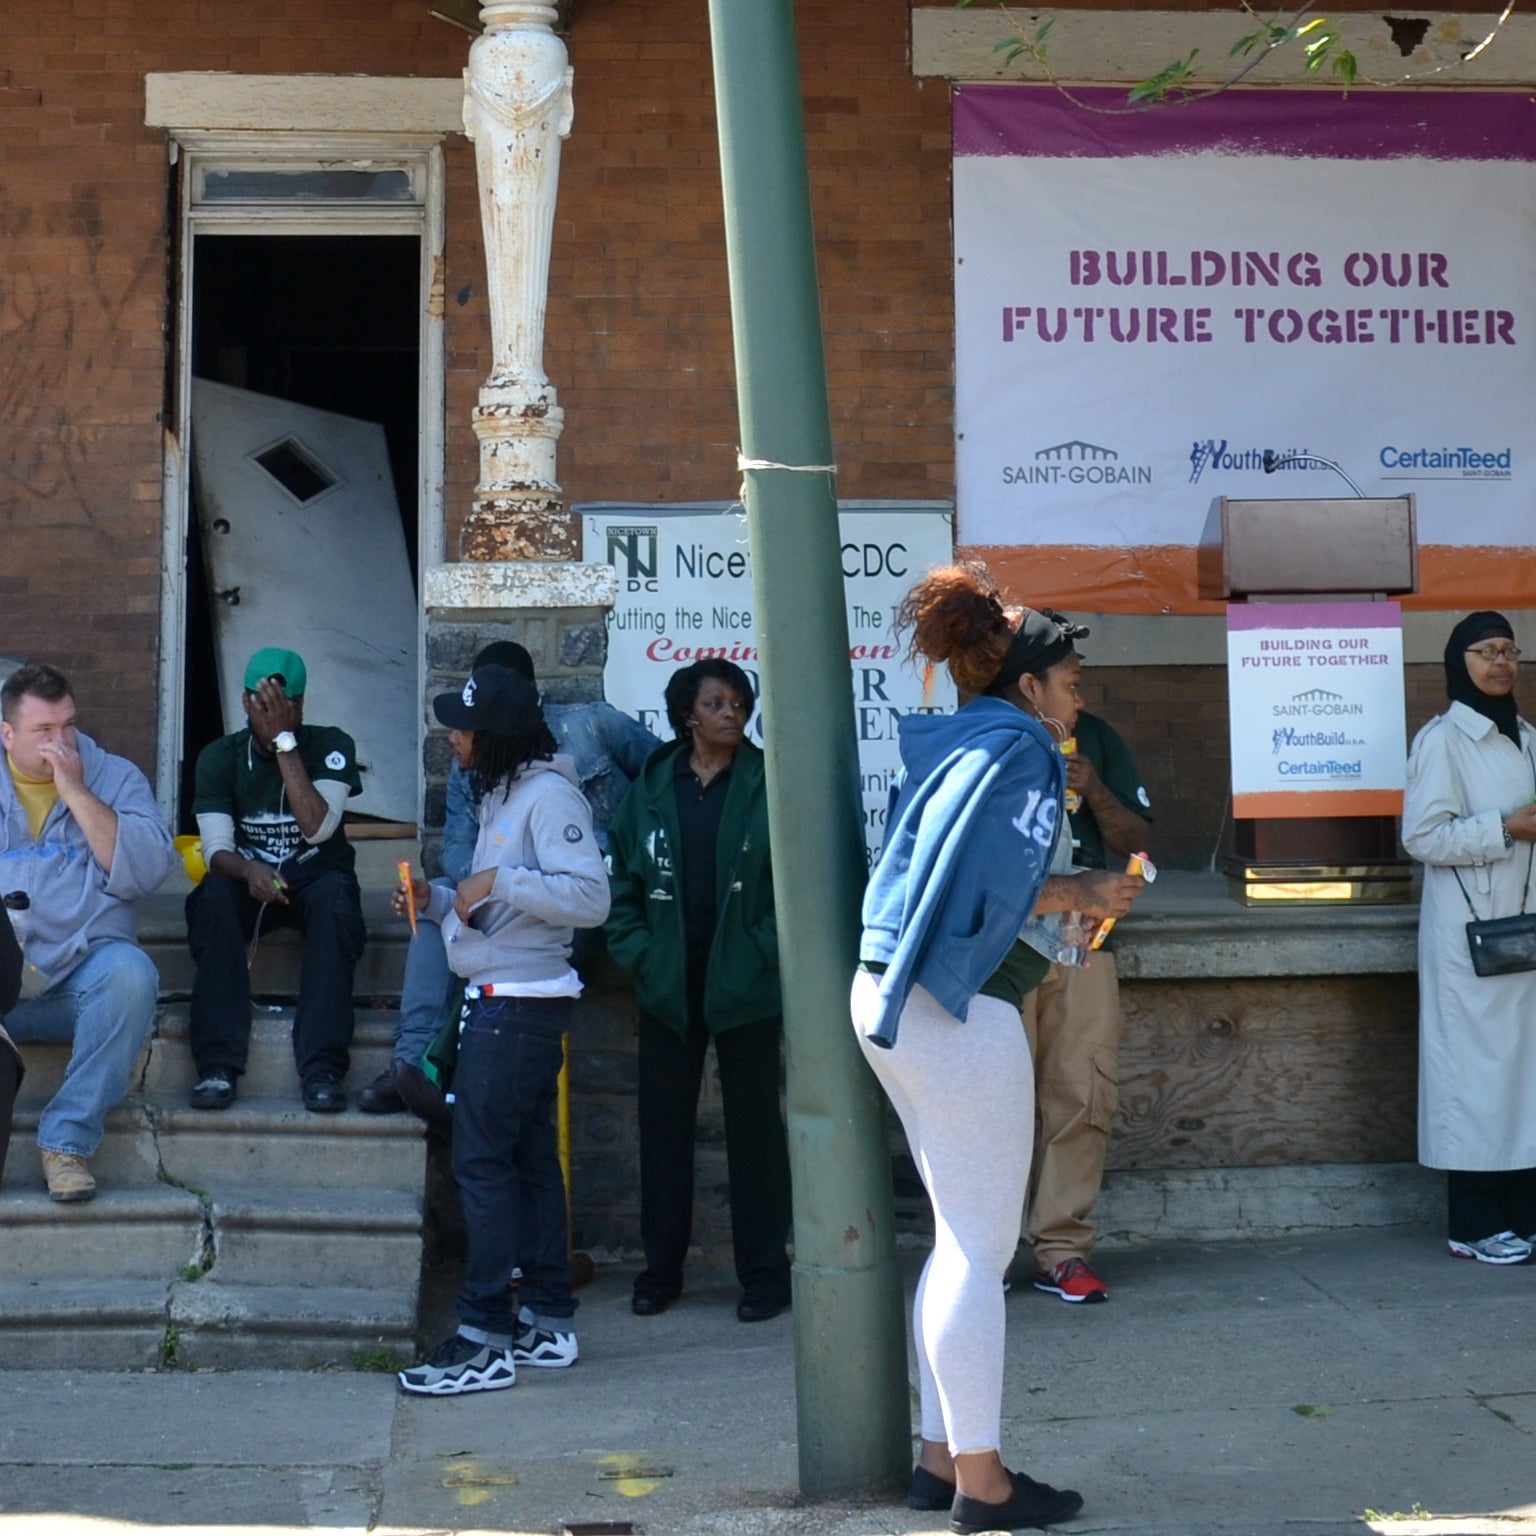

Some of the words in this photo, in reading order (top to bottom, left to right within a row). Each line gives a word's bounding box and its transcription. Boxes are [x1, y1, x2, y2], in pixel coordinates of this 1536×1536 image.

[1069, 251, 1321, 287] BUILDING
[1344, 252, 1449, 288] OUR
[1002, 307, 1212, 343] FUTURE
[1234, 309, 1516, 345] TOGETHER
[1209, 440, 1309, 470] Youthuild
[1380, 446, 1511, 468] CertainTeed
[1003, 466, 1151, 484] SAINT-GOBAIN
[607, 527, 657, 536] NICETOWN
[841, 543, 907, 578] CDC
[614, 579, 659, 593] DC
[607, 607, 665, 634] Putting
[675, 607, 703, 629] the
[852, 606, 882, 629] The
[646, 637, 759, 662] Comin
[1260, 639, 1332, 651] BUILDING
[1338, 638, 1369, 649] OUR
[1241, 655, 1302, 667] FUTURE
[1307, 654, 1389, 666] TOGETHER
[1272, 704, 1363, 716] SAINT-GOBAIN
[1283, 727, 1345, 746] YouthBuild
[1278, 760, 1362, 775] CertainTeed
